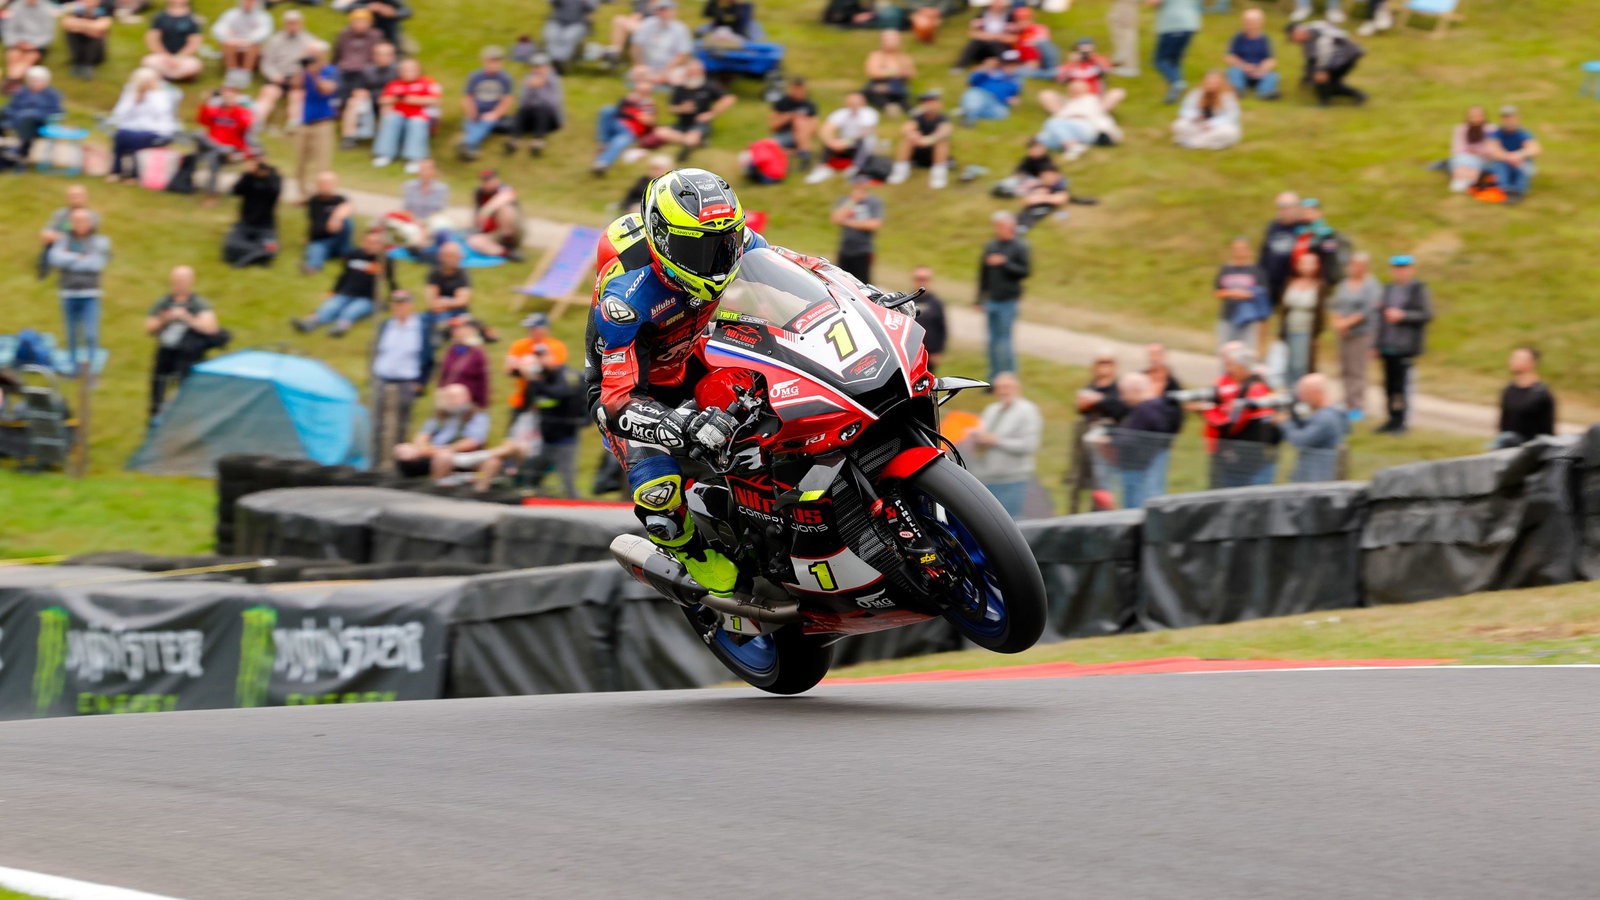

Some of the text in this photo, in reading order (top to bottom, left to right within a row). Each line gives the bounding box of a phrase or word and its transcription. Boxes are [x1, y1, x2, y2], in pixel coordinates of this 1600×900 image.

[702, 208, 731, 217] LS2
[625, 270, 645, 299] IXON
[651, 297, 676, 315] bitubo
[825, 318, 858, 361] 1
[770, 384, 800, 398] OMG
[619, 414, 655, 440] OMG
[895, 499, 922, 538] PIRELLI
[920, 553, 937, 564] sbs
[808, 561, 839, 591] 1
[730, 615, 742, 632] 1
